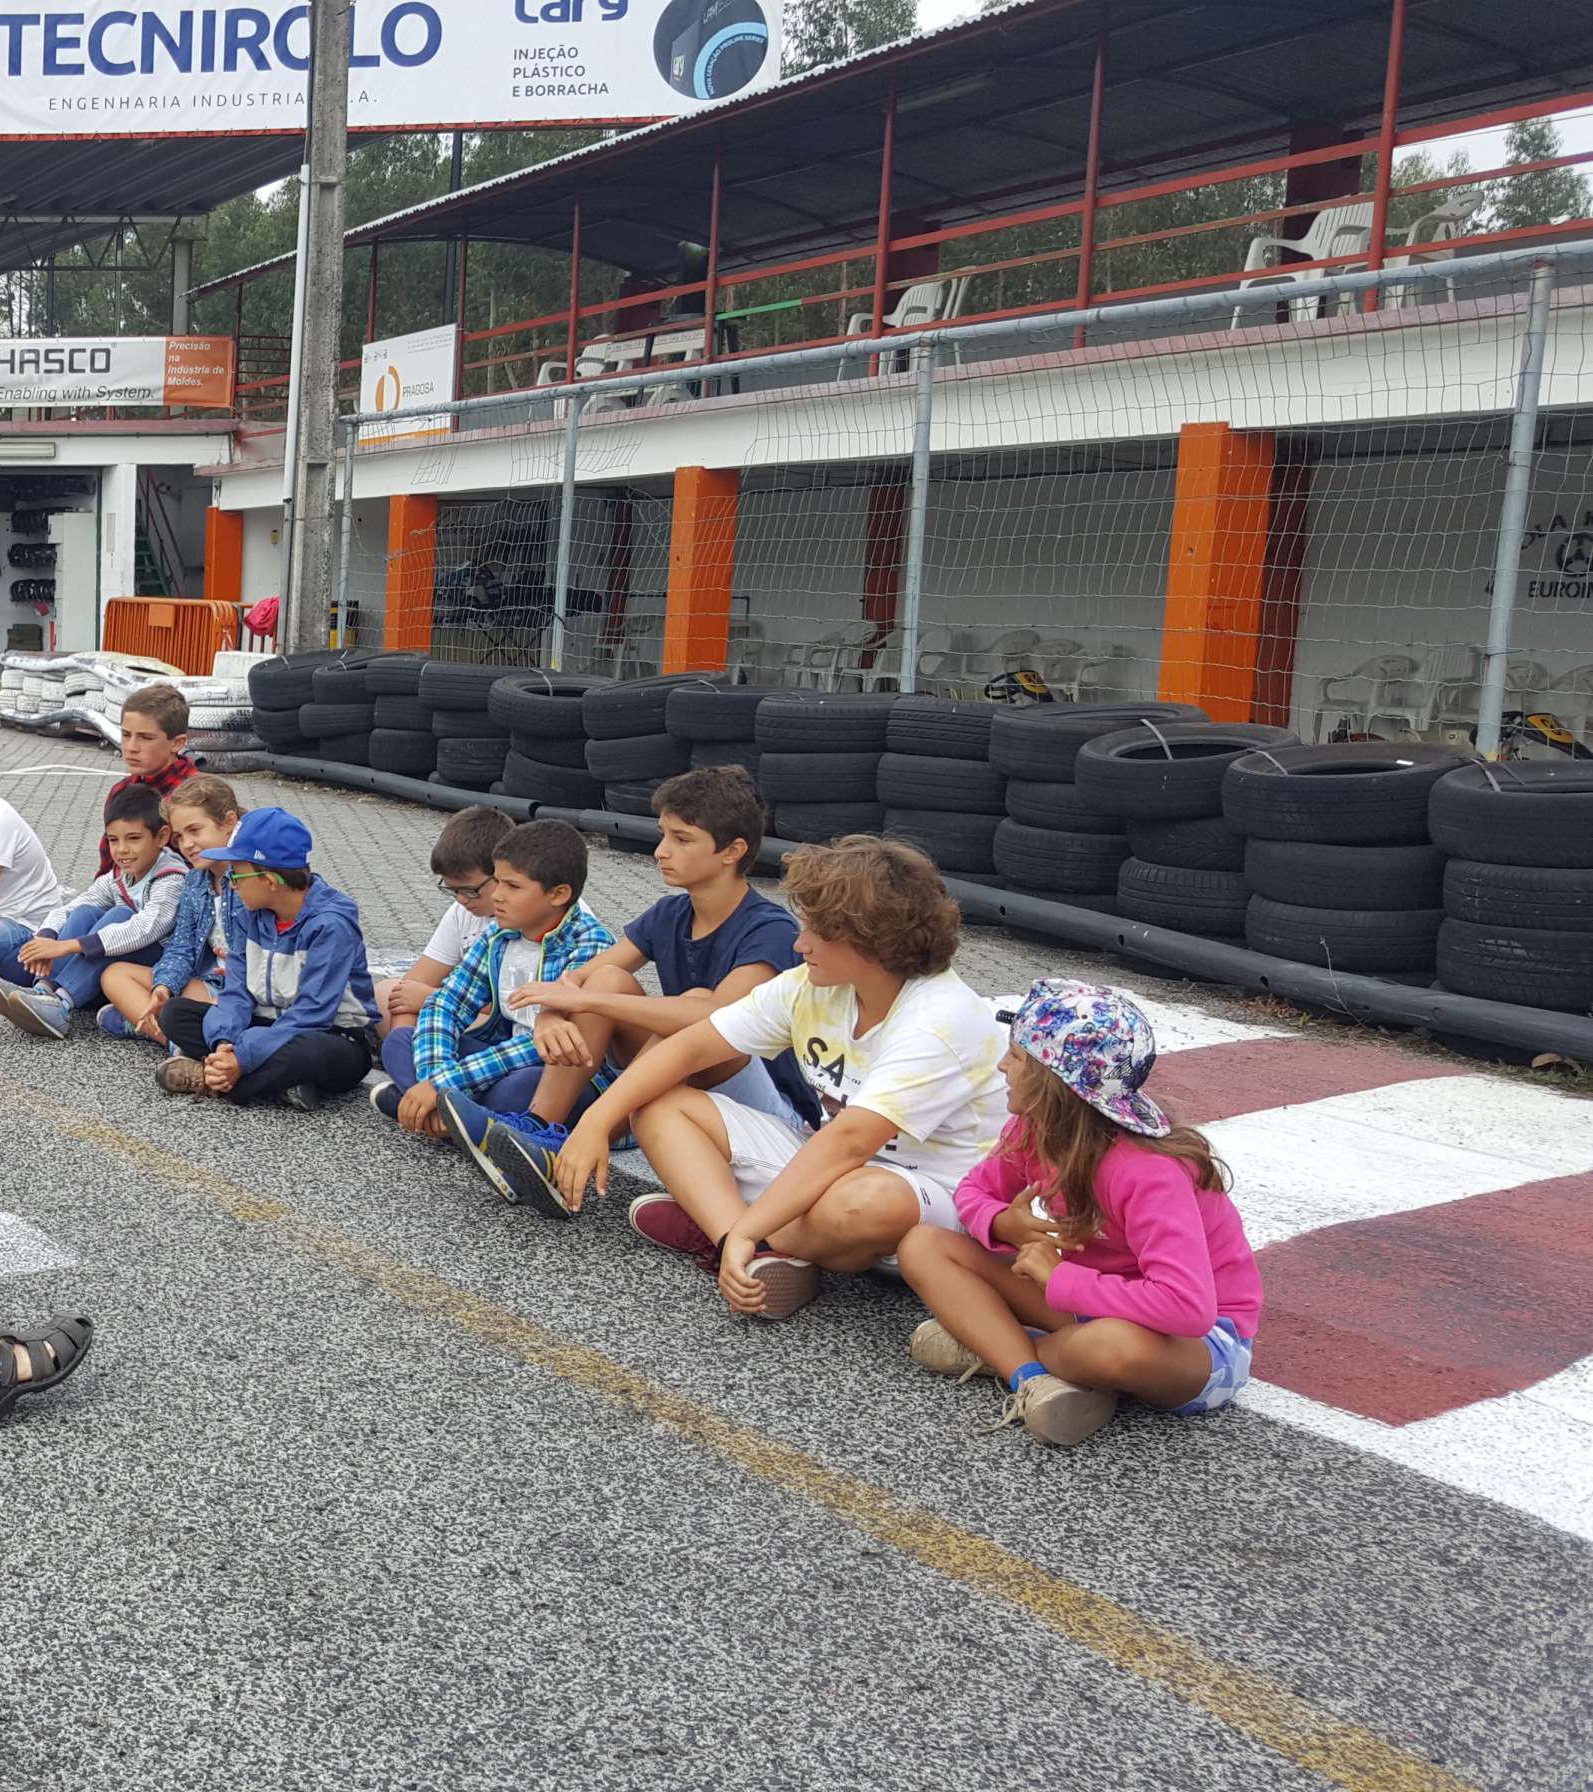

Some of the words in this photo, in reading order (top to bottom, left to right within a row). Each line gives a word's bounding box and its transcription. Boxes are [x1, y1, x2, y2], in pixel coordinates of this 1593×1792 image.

[513, 45, 578, 62] INJEÇÃO
[513, 64, 585, 79] PLÁSTICO
[512, 86, 520, 97] E
[525, 83, 609, 97] BORRACHA
[49, 96, 181, 110] ENGENHARIA
[193, 92, 305, 107] INDUSTRIA
[350, 91, 379, 103] .A.
[169, 341, 210, 351] Precisão
[169, 353, 180, 362] na
[212, 365, 224, 374] de
[62, 386, 90, 400] with
